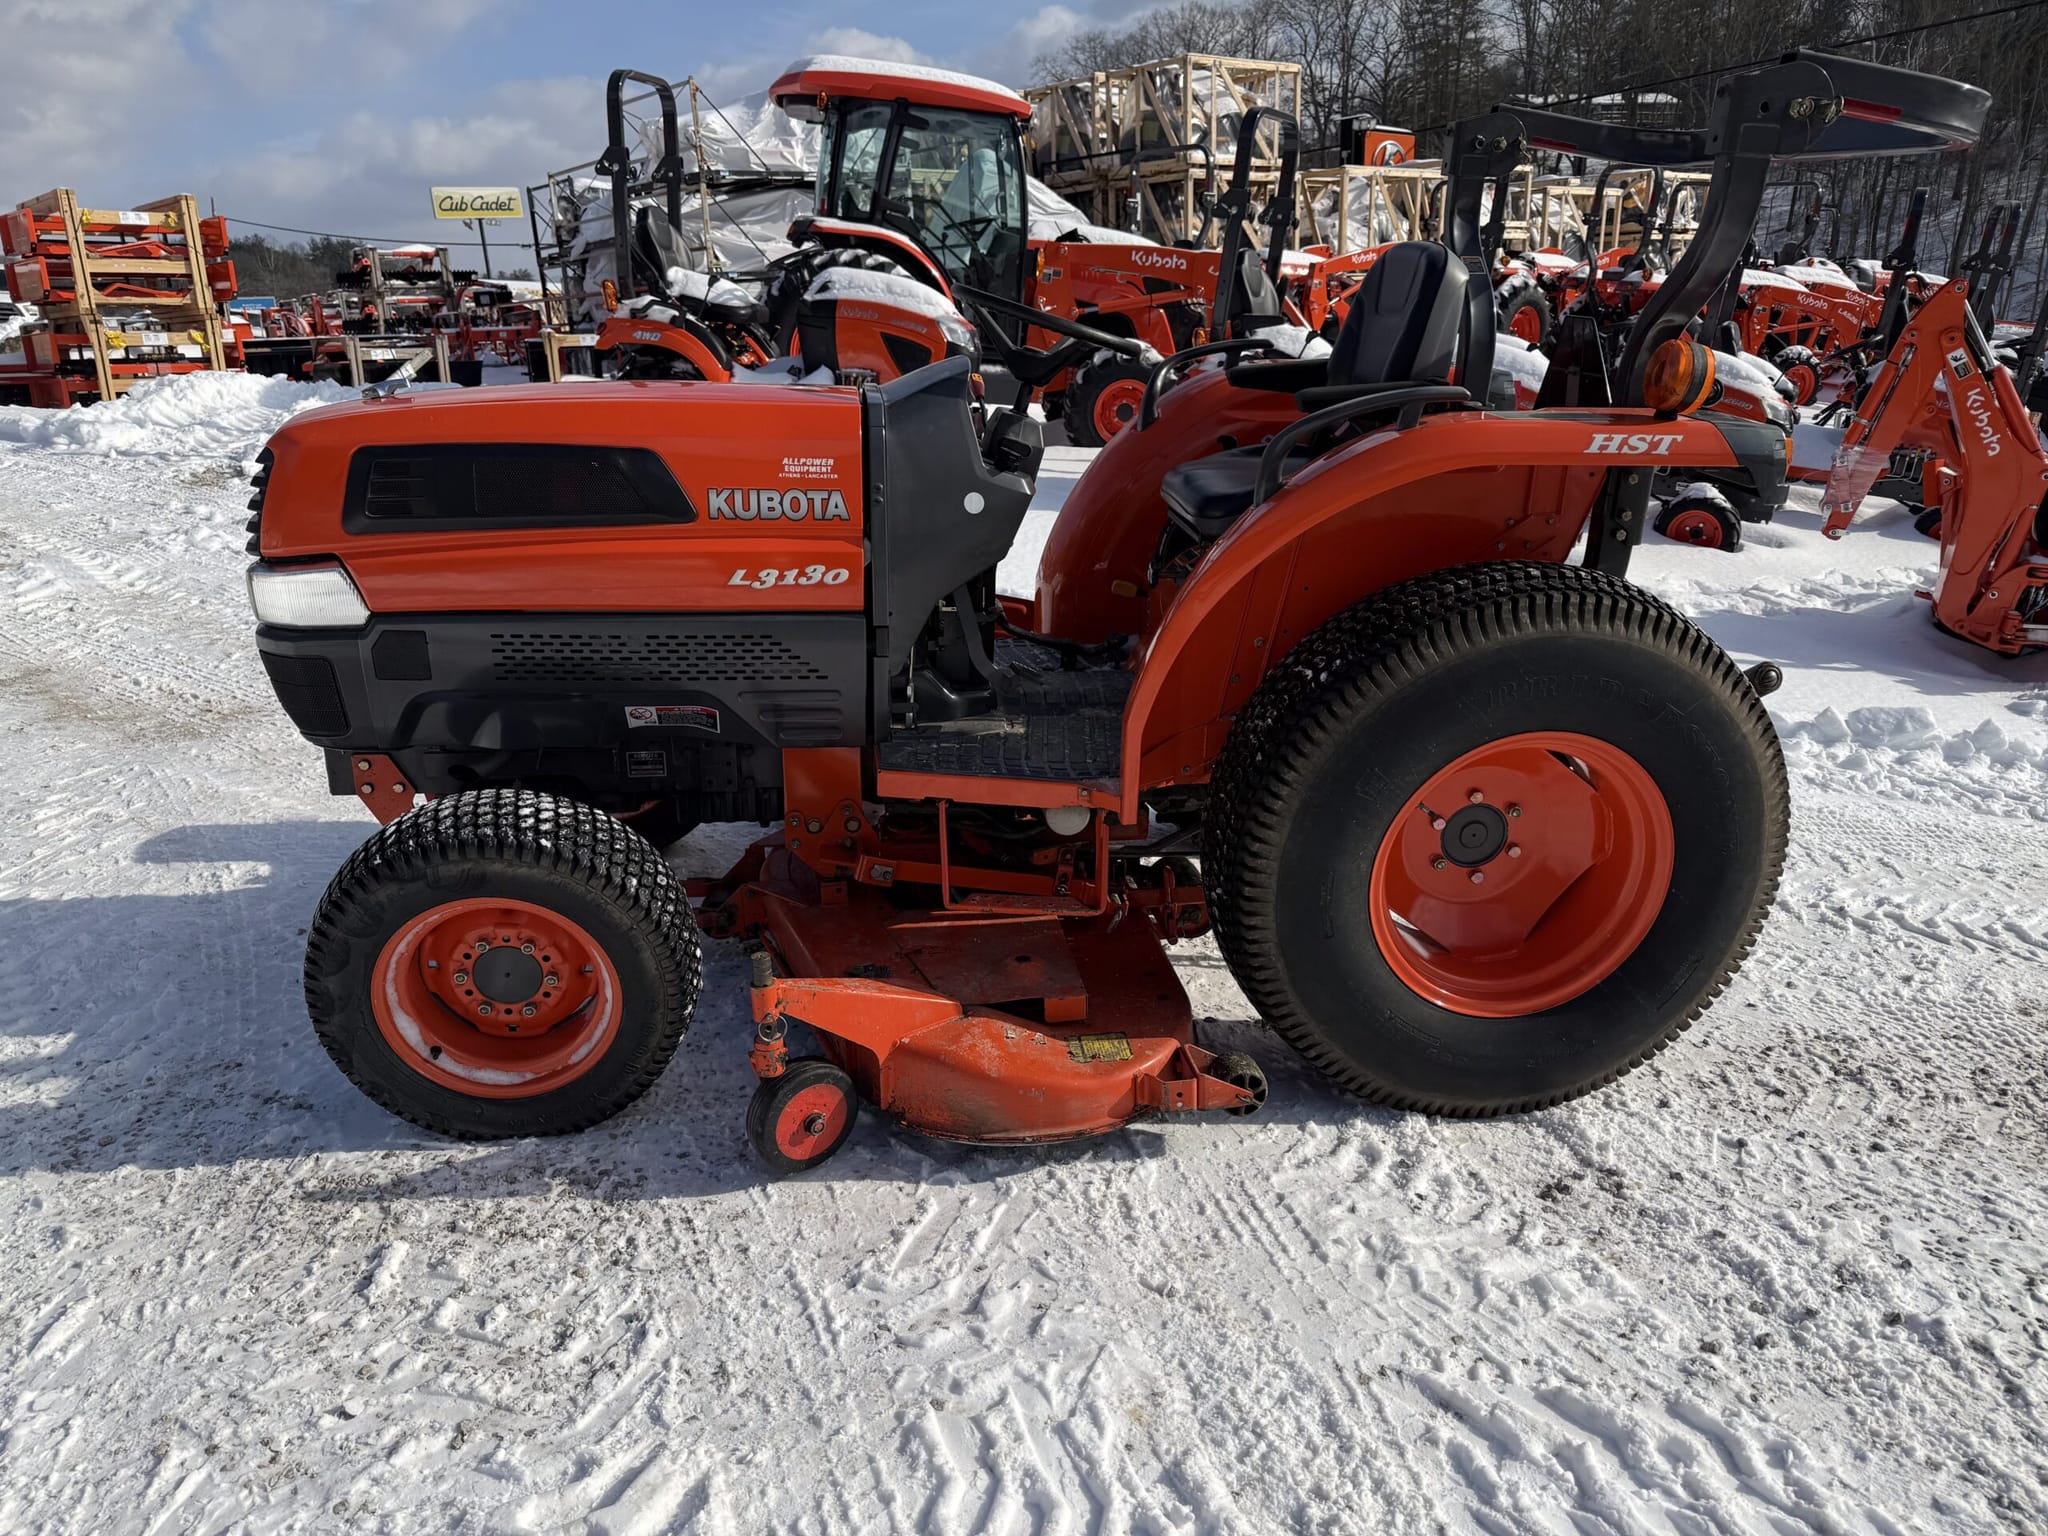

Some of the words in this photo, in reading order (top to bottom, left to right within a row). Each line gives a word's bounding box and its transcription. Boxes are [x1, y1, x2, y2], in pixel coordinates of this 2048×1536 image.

[438, 195, 469, 212] Cub
[469, 195, 517, 212] Cadet
[1131, 249, 1188, 270] Kubota
[1351, 251, 1378, 265] Kubota
[1797, 293, 1829, 311] Kubota
[1966, 387, 2001, 457] Kubota
[1583, 433, 1684, 456] HST
[782, 457, 834, 466] ALLPOWER
[784, 465, 832, 473] EQUIPMENT
[708, 488, 851, 522] KUBOTA
[728, 564, 850, 590] L3130
